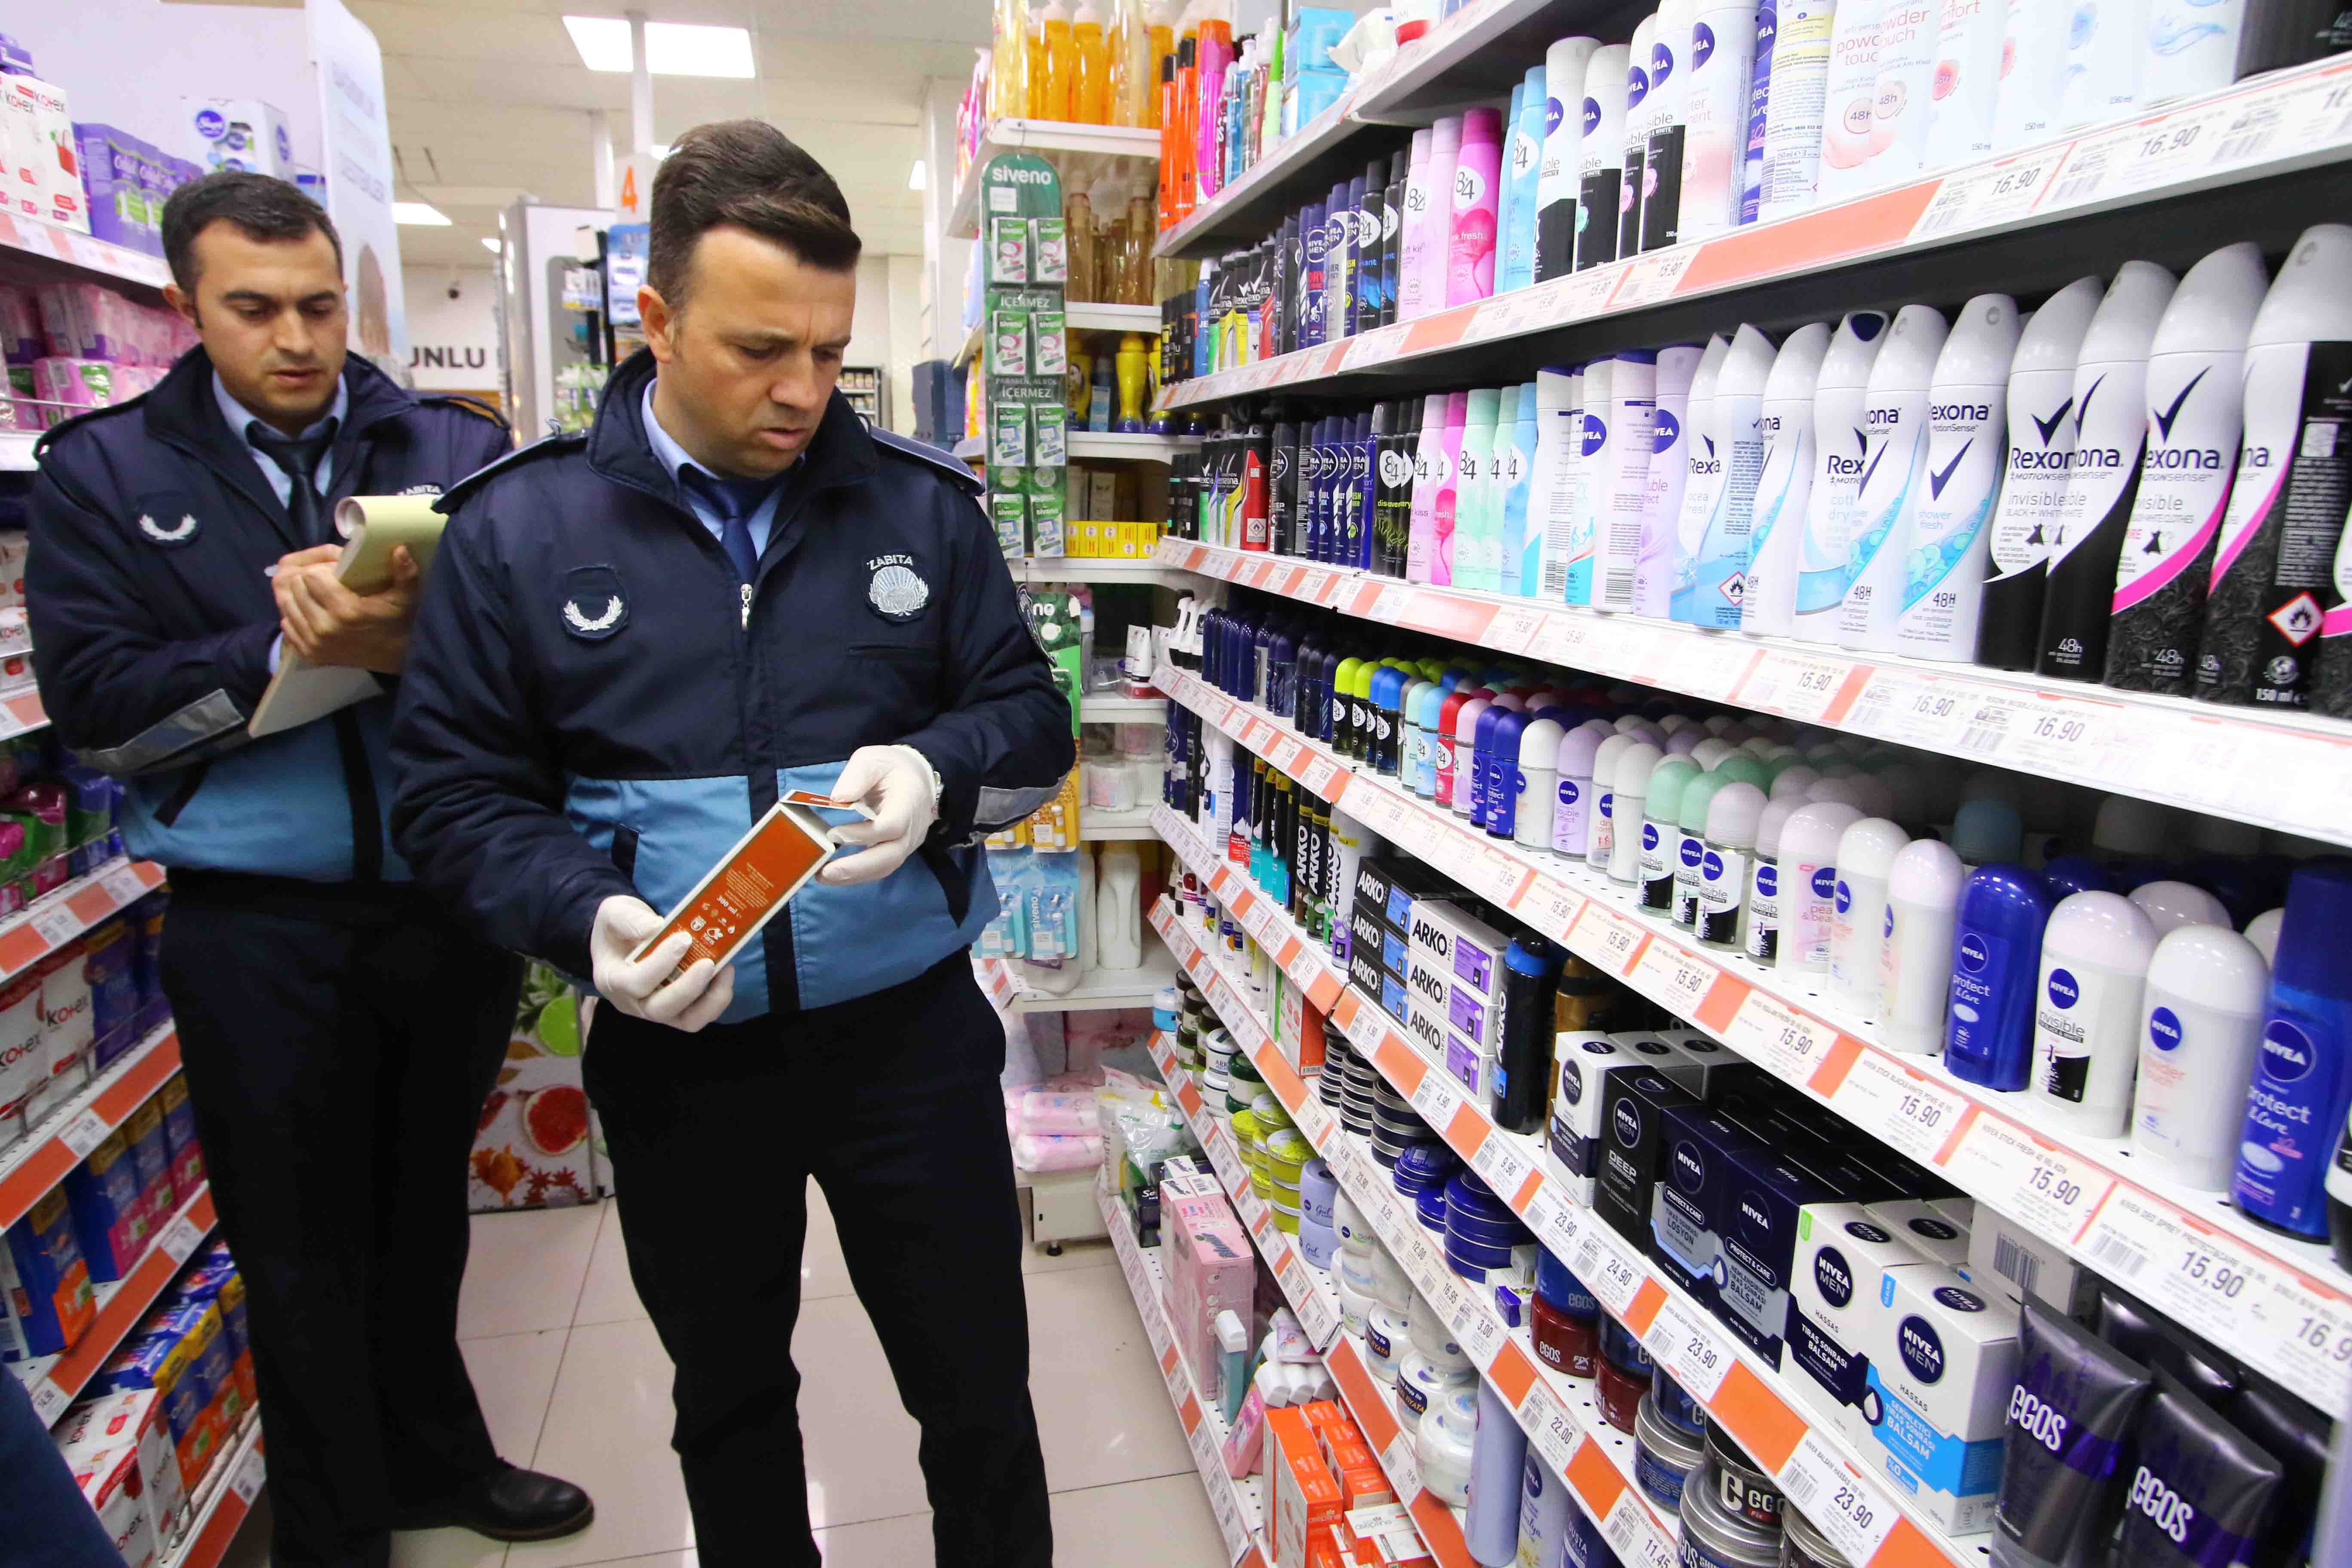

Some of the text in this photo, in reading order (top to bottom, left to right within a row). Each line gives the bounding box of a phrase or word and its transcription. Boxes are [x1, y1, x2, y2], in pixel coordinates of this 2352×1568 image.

[2139, 125, 2201, 157] 16,90
[992, 165, 1051, 185] siveno
[1992, 168, 2041, 196] 16,90
[622, 166, 637, 214] 4
[1461, 231, 1483, 241] fresh
[1001, 387, 1051, 398] İÇERMEZ
[869, 555, 913, 570] ZABITA
[1932, 592, 1956, 608] 48H
[1798, 671, 1832, 691] 15,90
[1913, 694, 1955, 718] 16,90
[2034, 716, 2085, 742] 16,90
[1296, 825, 1309, 885] ARKO
[1309, 832, 1321, 894] ARKO
[1682, 848, 1701, 858] NIVEA
[1703, 862, 1719, 872] NIVEA
[1357, 871, 1384, 905] ARKO
[717, 894, 738, 916] 300 ml
[1551, 900, 1571, 919] 15,90
[1352, 914, 1380, 948] ARKO
[1412, 919, 1447, 957] ARKO
[1606, 931, 1630, 952] 15,90
[1961, 946, 1984, 961] NIVEA
[1351, 956, 1378, 990] ARKO
[1410, 965, 1443, 1005] ARKO
[1674, 969, 1702, 992] 15,90
[1954, 974, 1991, 997] protect
[2050, 981, 2076, 998] NIVEA
[1410, 1010, 1441, 1051] ARKO
[1780, 1028, 1813, 1054] 15,90
[2150, 1020, 2179, 1039] NIVEA
[2262, 1040, 2307, 1067] NIVEA
[1564, 1069, 1580, 1089] NIVEA
[1436, 1093, 1450, 1108] 4,90
[1900, 1095, 1941, 1127] 15,90
[1617, 1108, 1637, 1130] NIVEA
[1617, 1118, 1634, 1138] MEN
[1501, 1157, 1516, 1177] 9,90
[1608, 1149, 1637, 1177] DEEP
[1678, 1150, 1701, 1176] NIVEA
[2029, 1167, 2080, 1205] 15,90
[1667, 1190, 1685, 1207] PROTECT
[1690, 1207, 1703, 1221] CARE
[1742, 1203, 1769, 1230] NIVEA
[1555, 1212, 1578, 1237] 23,90
[1667, 1218, 1694, 1245] LOSYON
[1607, 1259, 1632, 1286] 24,90
[1730, 1243, 1752, 1264] PROTECT
[1756, 1263, 1771, 1279] CARE
[1818, 1256, 1850, 1289] NIVEA
[2181, 1251, 2245, 1298] 15,90
[1443, 1282, 1459, 1304] 16,95
[1730, 1280, 1762, 1313] BALSAM
[1819, 1271, 1846, 1300] MEN
[1477, 1319, 1493, 1339] 3,00
[1816, 1310, 1839, 1333] HASSAS
[1687, 1338, 1717, 1369] 23,90
[1808, 1340, 1837, 1371] BALSAM
[1820, 1341, 1847, 1369] SONRASI
[1903, 1325, 1942, 1366] NIVEA
[1903, 1347, 1937, 1375] MEN
[1900, 1384, 1928, 1412] HASSAS
[1550, 1417, 1573, 1445] 22,00
[1887, 1416, 1929, 1460] BALSAM
[1817, 1452, 1834, 1470] BALSAM
[1834, 1467, 1851, 1485] HASSAS
[1834, 1487, 1873, 1528] 23,90
[1645, 1539, 1671, 1568] 11,45
